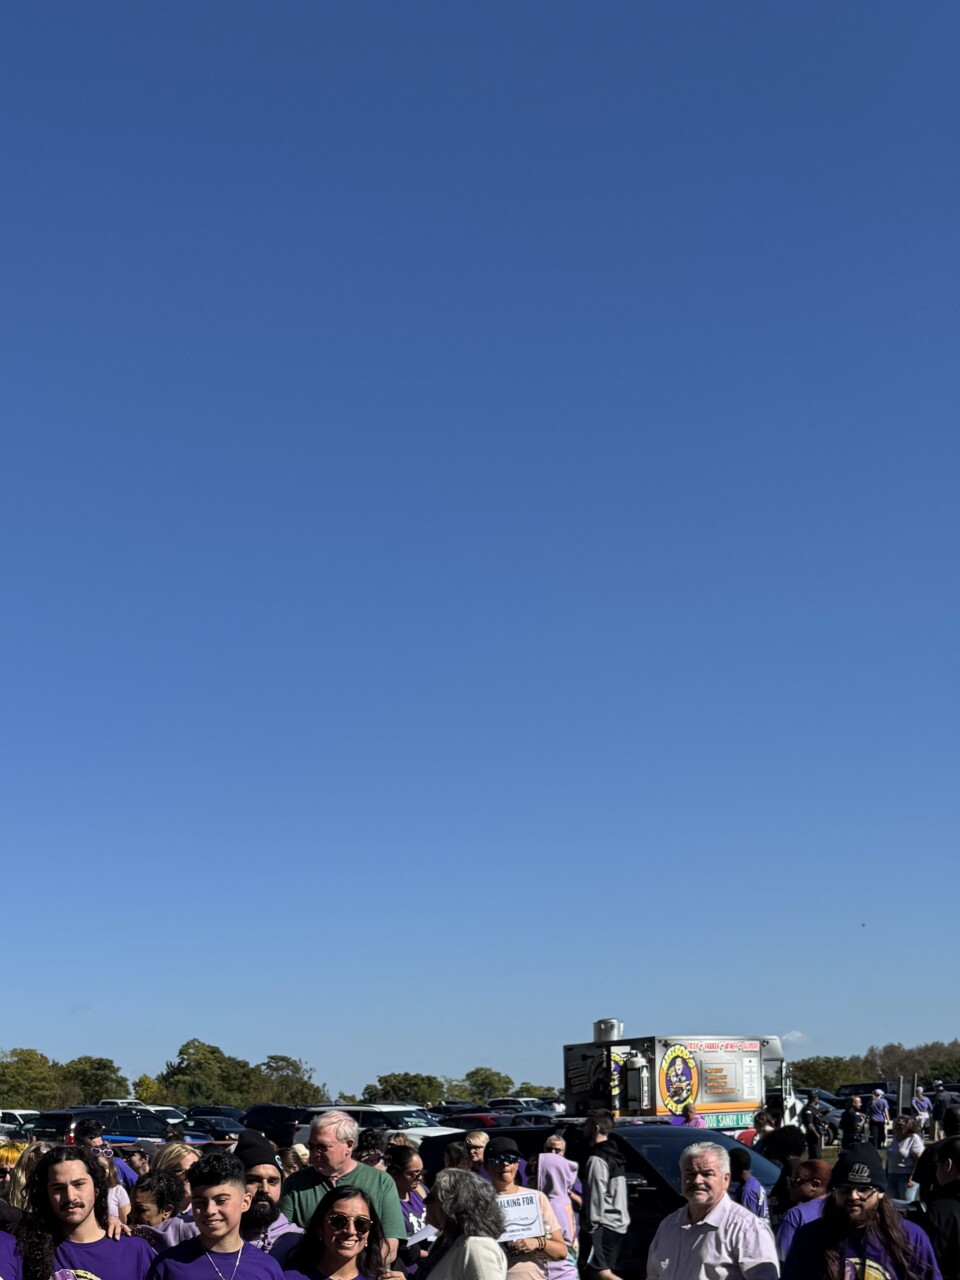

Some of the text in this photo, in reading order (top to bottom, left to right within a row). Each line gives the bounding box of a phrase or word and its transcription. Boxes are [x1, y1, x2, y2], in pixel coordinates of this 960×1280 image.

[719, 1114, 737, 1127] SANDY
[739, 1113, 754, 1126] LANE
[497, 1196, 535, 1209] ALKING FOR
